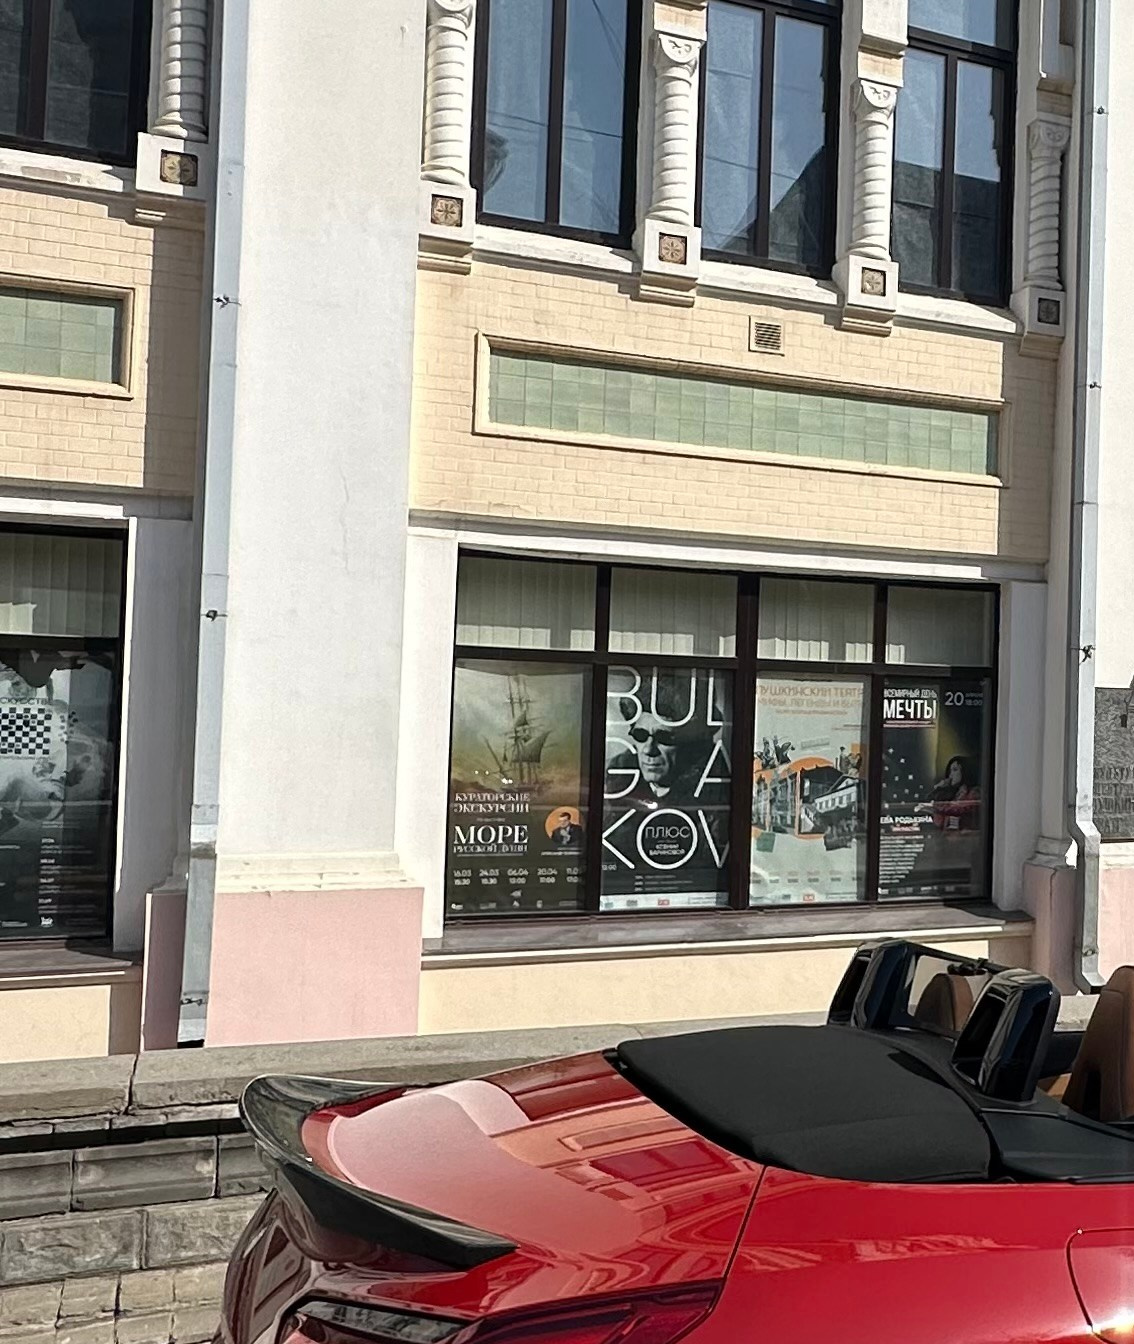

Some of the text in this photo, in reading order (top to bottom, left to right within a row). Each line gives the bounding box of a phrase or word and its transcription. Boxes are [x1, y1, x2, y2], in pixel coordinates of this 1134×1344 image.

[945, 692, 964, 706] 20
[883, 699, 937, 719] МЕЧТЫ
[453, 803, 530, 813] ЭКСКУРСИИ
[453, 825, 529, 844] МОРЕ
[645, 826, 691, 838] ПЛЮС
